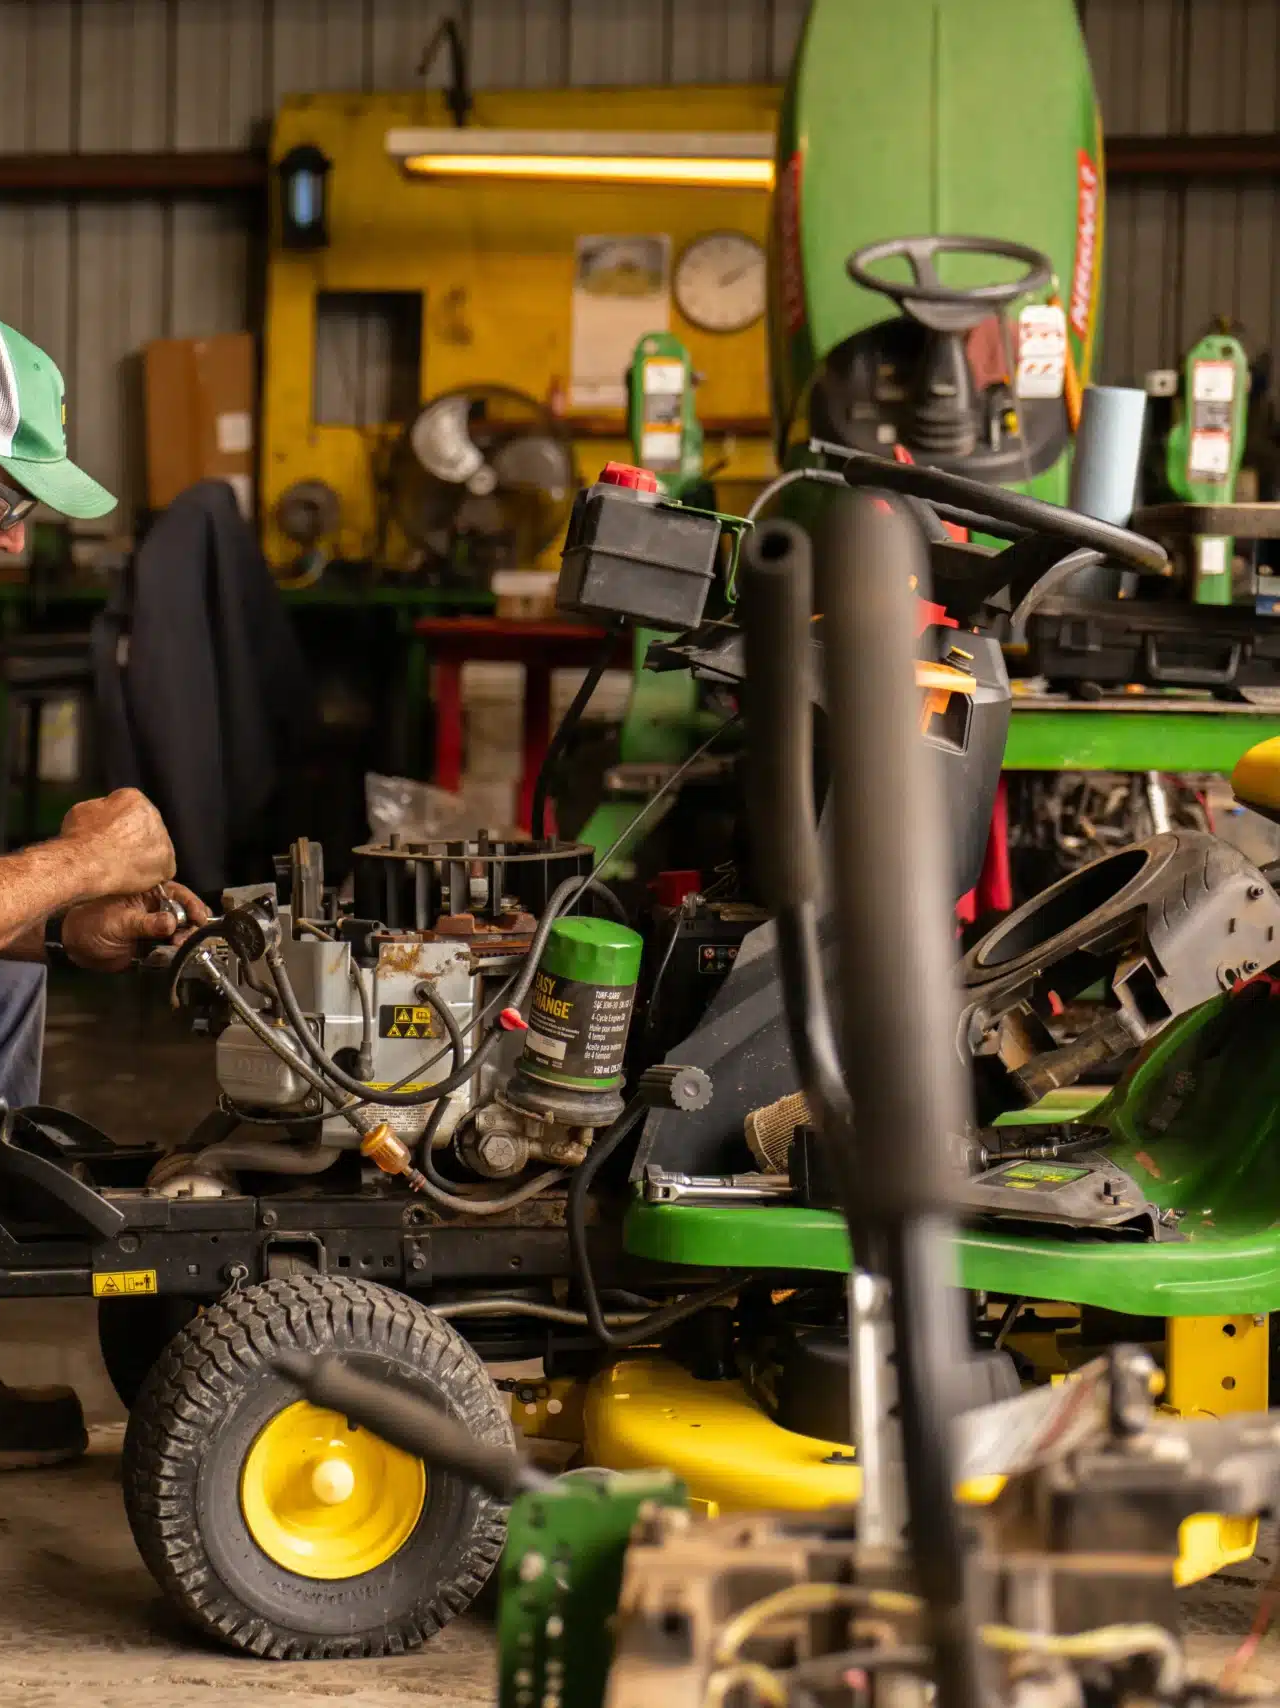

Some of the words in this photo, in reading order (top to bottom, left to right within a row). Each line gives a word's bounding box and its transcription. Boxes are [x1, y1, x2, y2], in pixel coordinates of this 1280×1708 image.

[535, 971, 556, 996] EASY
[534, 990, 571, 1020] HANGE
[591, 1013, 608, 1023] 4-Cycle
[601, 1025, 611, 1033] pour
[592, 1032, 606, 1042] temps
[585, 1042, 600, 1051] Aceite
[600, 1044, 610, 1053] para
[584, 1051, 591, 1059] de
[593, 1065, 603, 1074] 750
